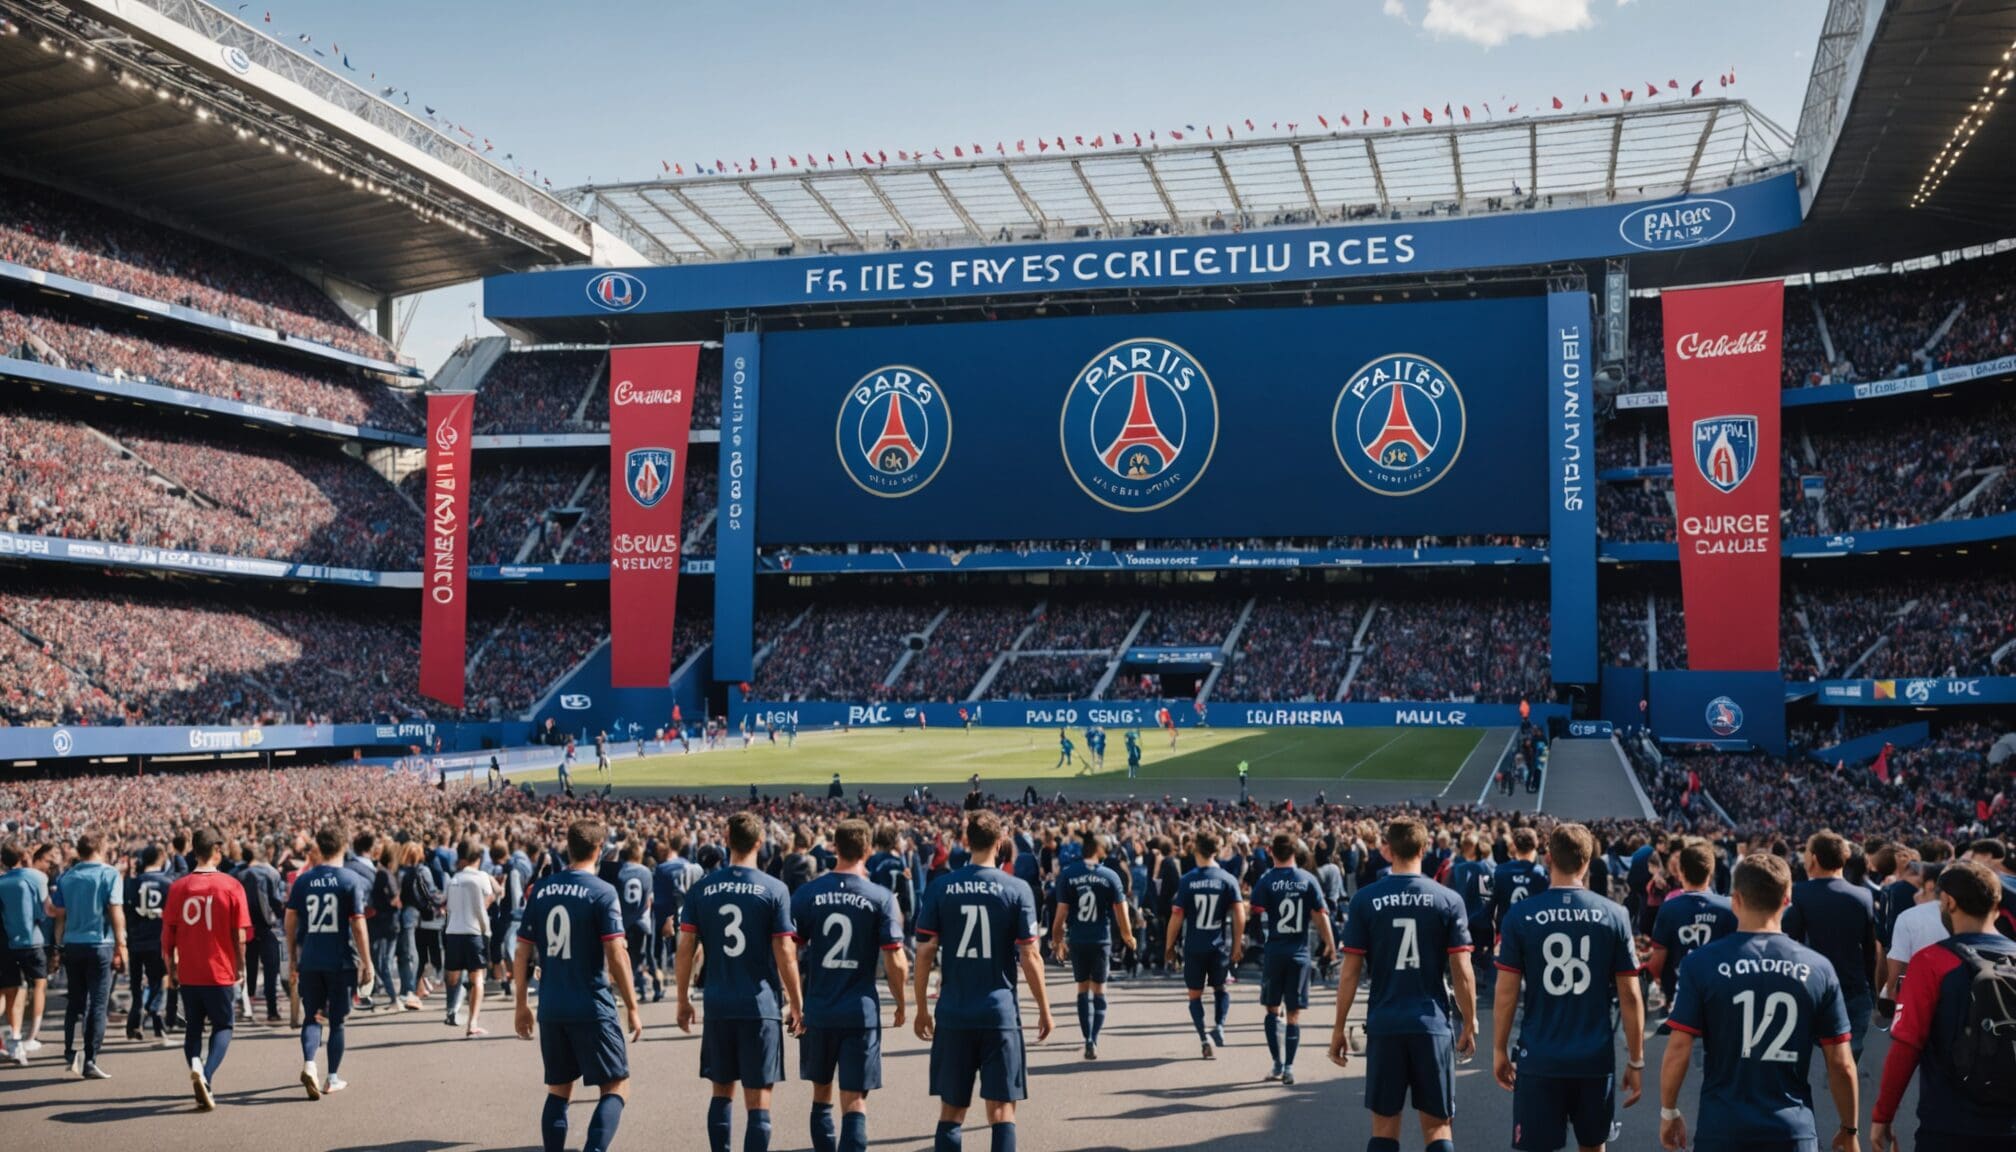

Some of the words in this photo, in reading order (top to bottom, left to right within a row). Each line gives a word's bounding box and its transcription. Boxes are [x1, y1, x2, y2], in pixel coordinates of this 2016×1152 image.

[718, 903, 747, 958] 3
[821, 912, 859, 970] 2
[1732, 989, 1799, 1063] 12
